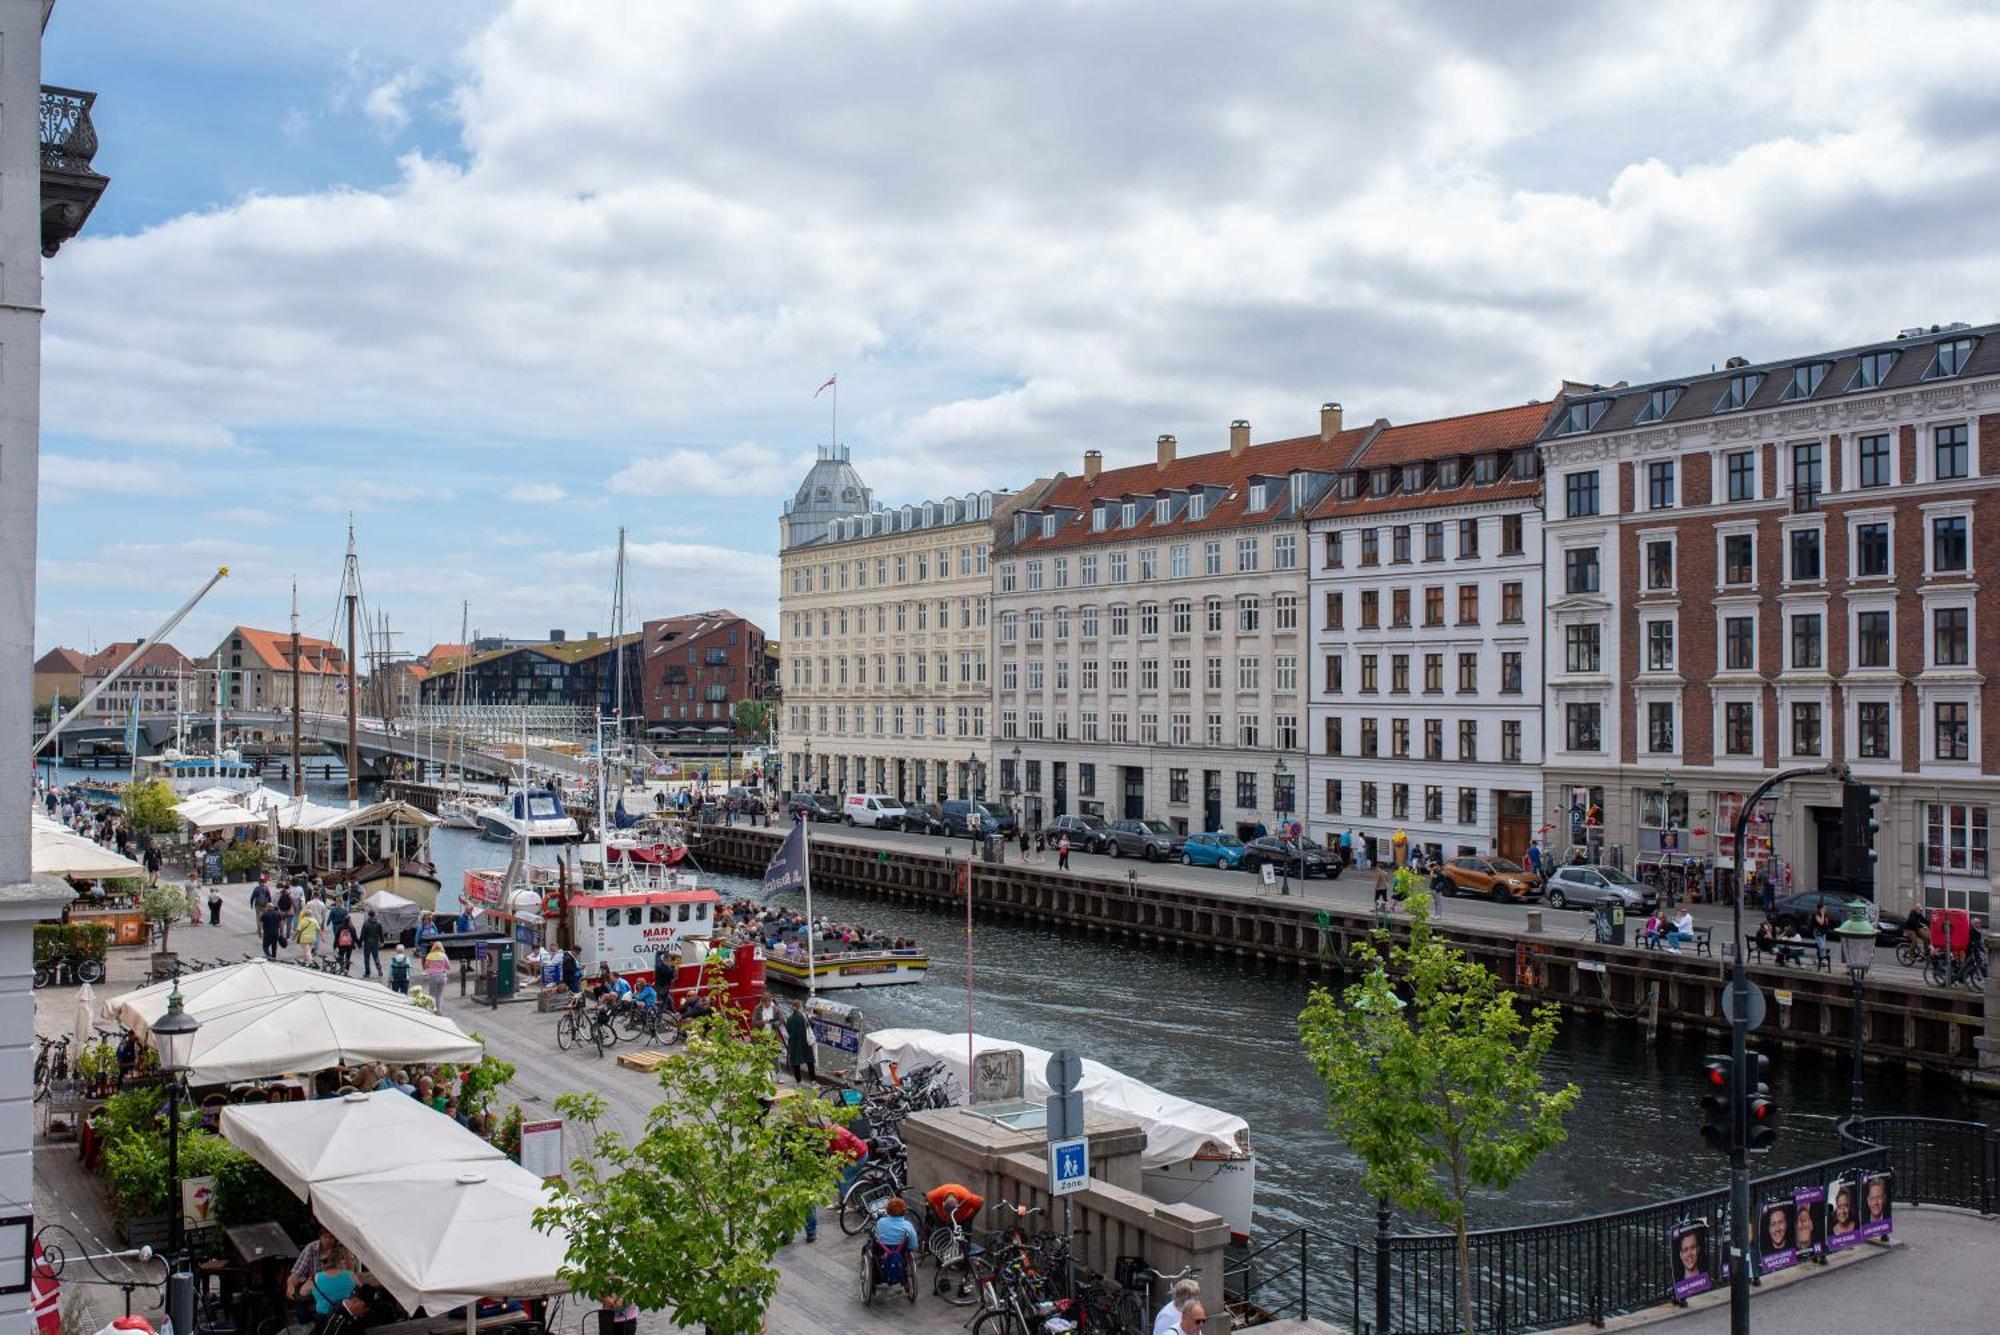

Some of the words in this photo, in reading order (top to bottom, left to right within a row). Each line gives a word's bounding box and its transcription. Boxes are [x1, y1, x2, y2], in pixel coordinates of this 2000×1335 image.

[643, 927, 676, 938] MARY
[633, 942, 682, 953] GARMIN
[1061, 1180, 1083, 1190] Zone
